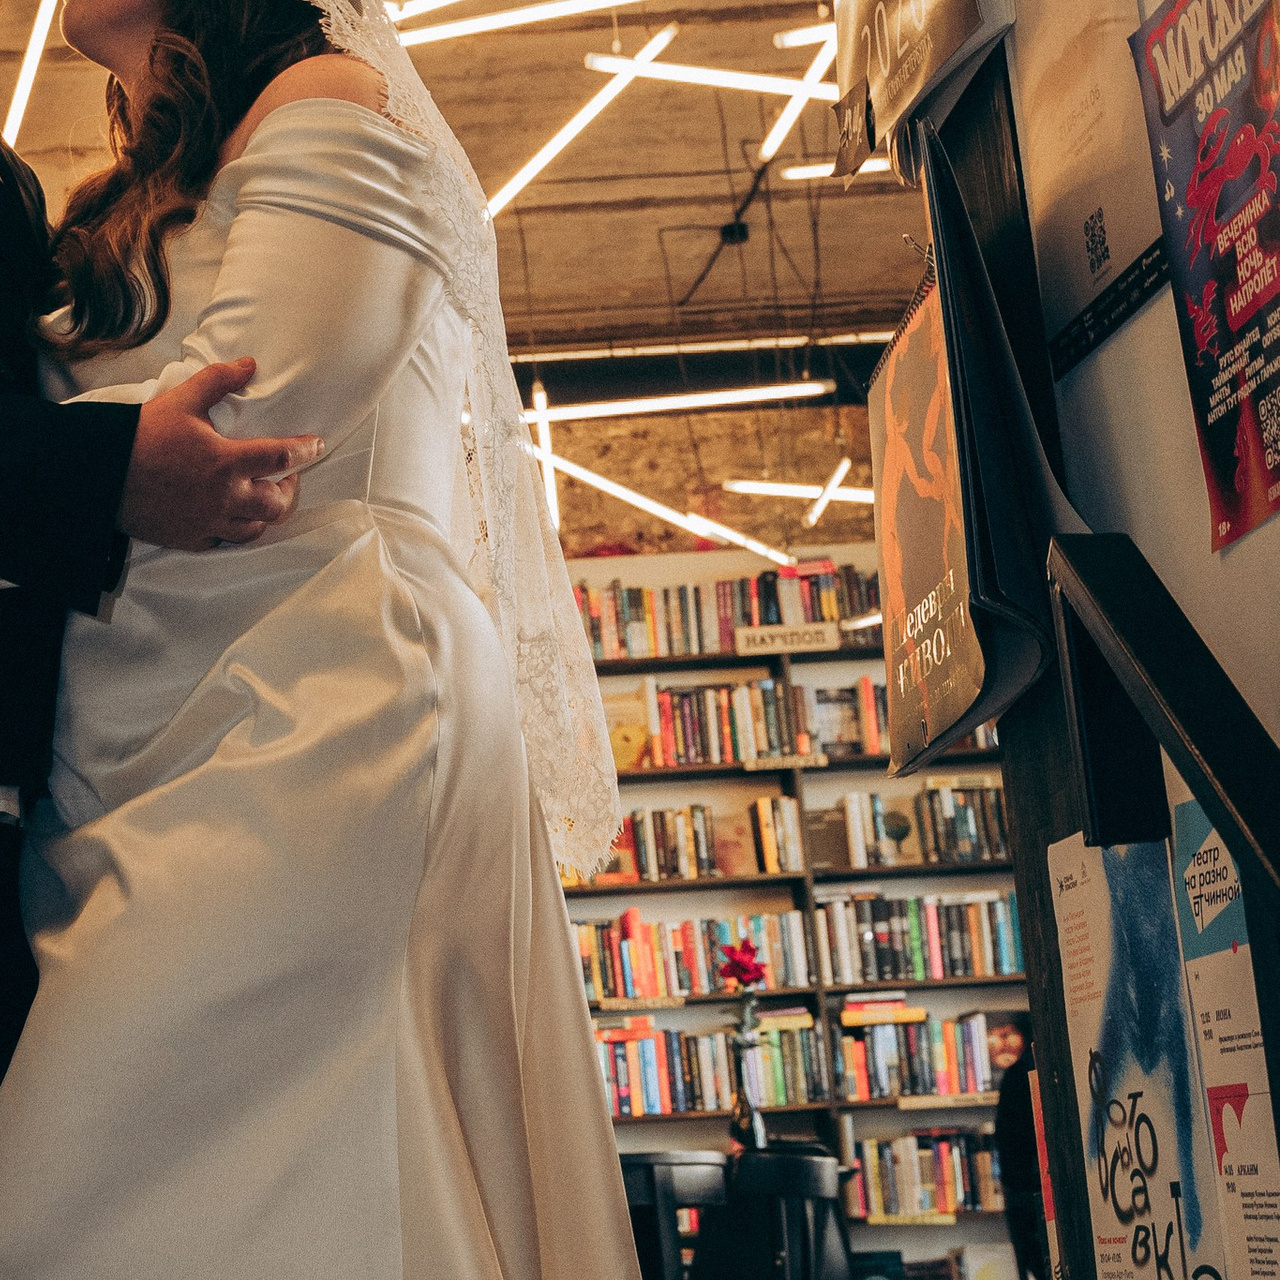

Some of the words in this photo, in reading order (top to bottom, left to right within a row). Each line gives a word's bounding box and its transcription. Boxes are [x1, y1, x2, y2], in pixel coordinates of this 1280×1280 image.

[1194, 83, 1214, 123] 30
[1213, 45, 1247, 104] МАЯ
[1216, 188, 1270, 254] ВЕЧЕРИНКА
[1235, 226, 1257, 261] ВСЮ
[1236, 247, 1263, 285] НОЧЬ
[1217, 520, 1231, 538] 18+
[1192, 846, 1220, 868] театр
[1184, 875, 1197, 892] на
[1199, 865, 1229, 890] разно
